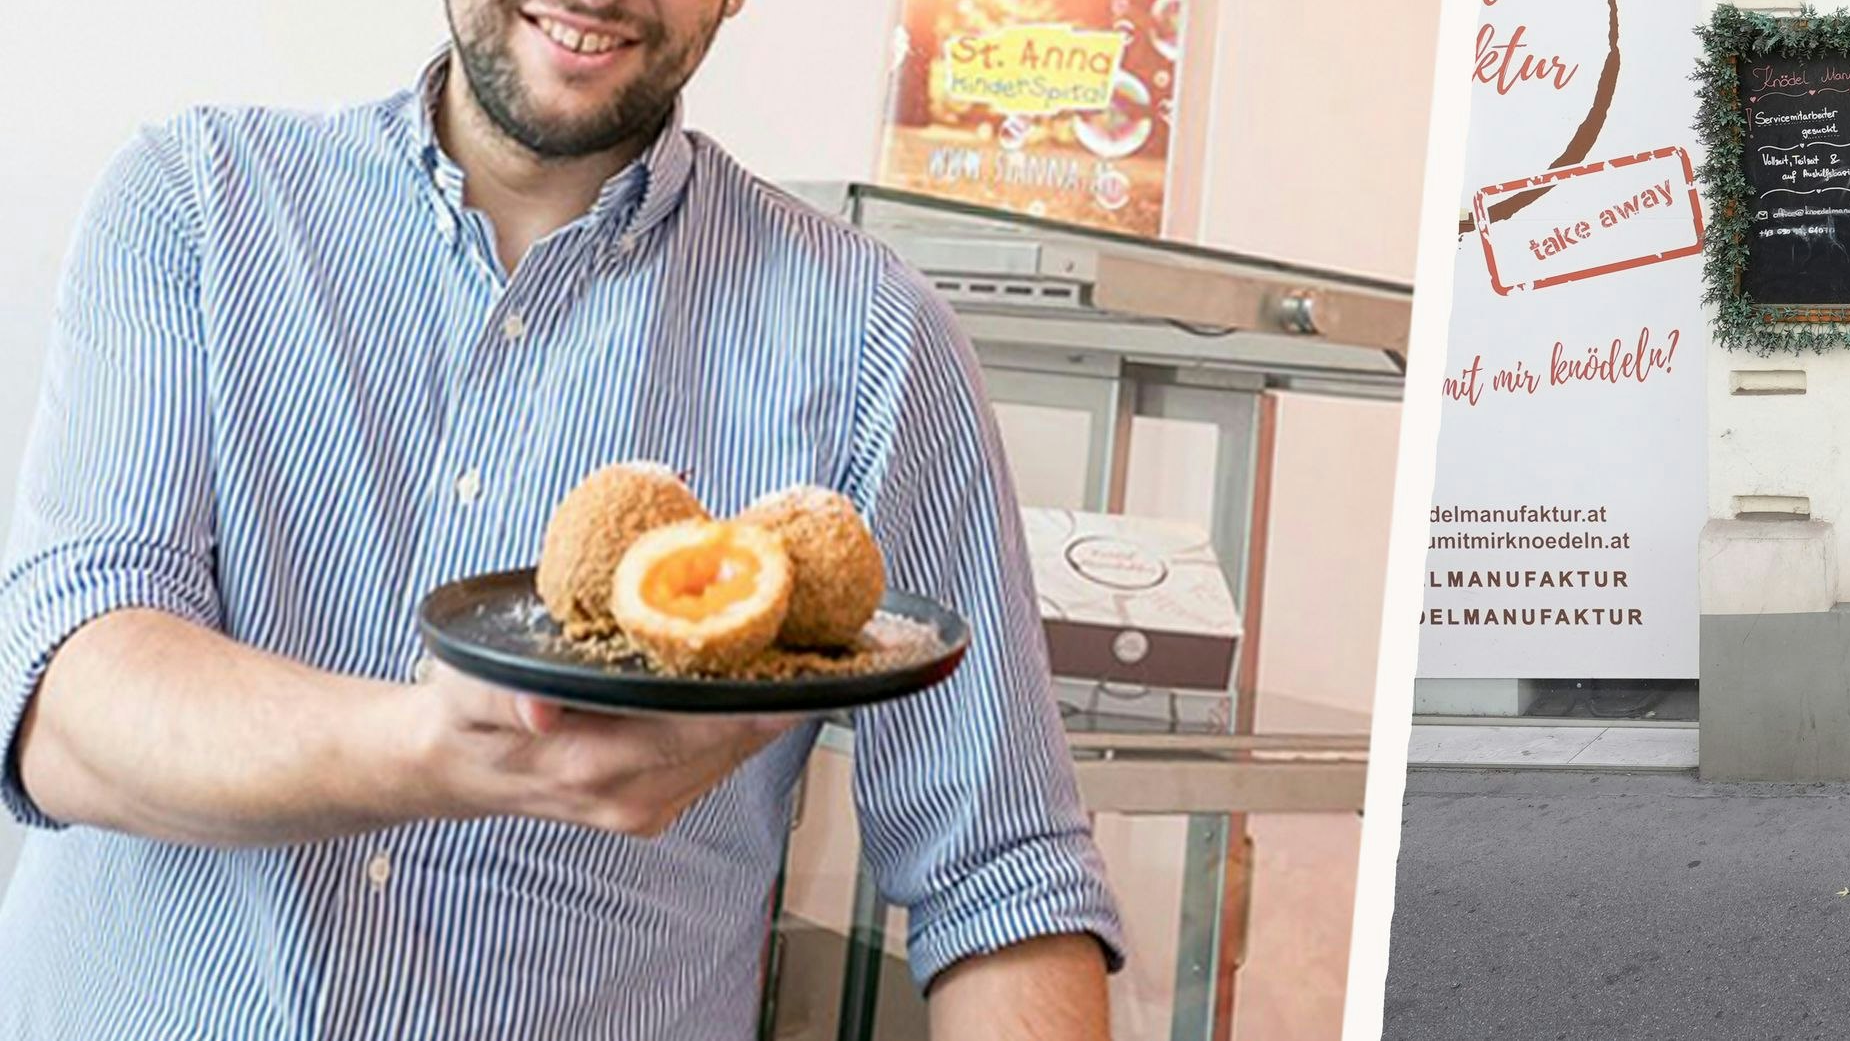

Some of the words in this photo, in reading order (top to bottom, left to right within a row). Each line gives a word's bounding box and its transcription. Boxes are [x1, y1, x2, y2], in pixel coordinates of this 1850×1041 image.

[1020, 39, 1113, 76] Anna
[1752, 65, 1810, 92] Knödel
[1755, 107, 1839, 125] Servicemitarbeiter
[1782, 170, 1797, 183] auf
[1528, 220, 1592, 261] take
[1599, 178, 1674, 229] away
[1493, 361, 1541, 394] mir
[1550, 327, 1680, 386] knödeln?
[1424, 571, 1629, 588] LMANUFAKTUR
